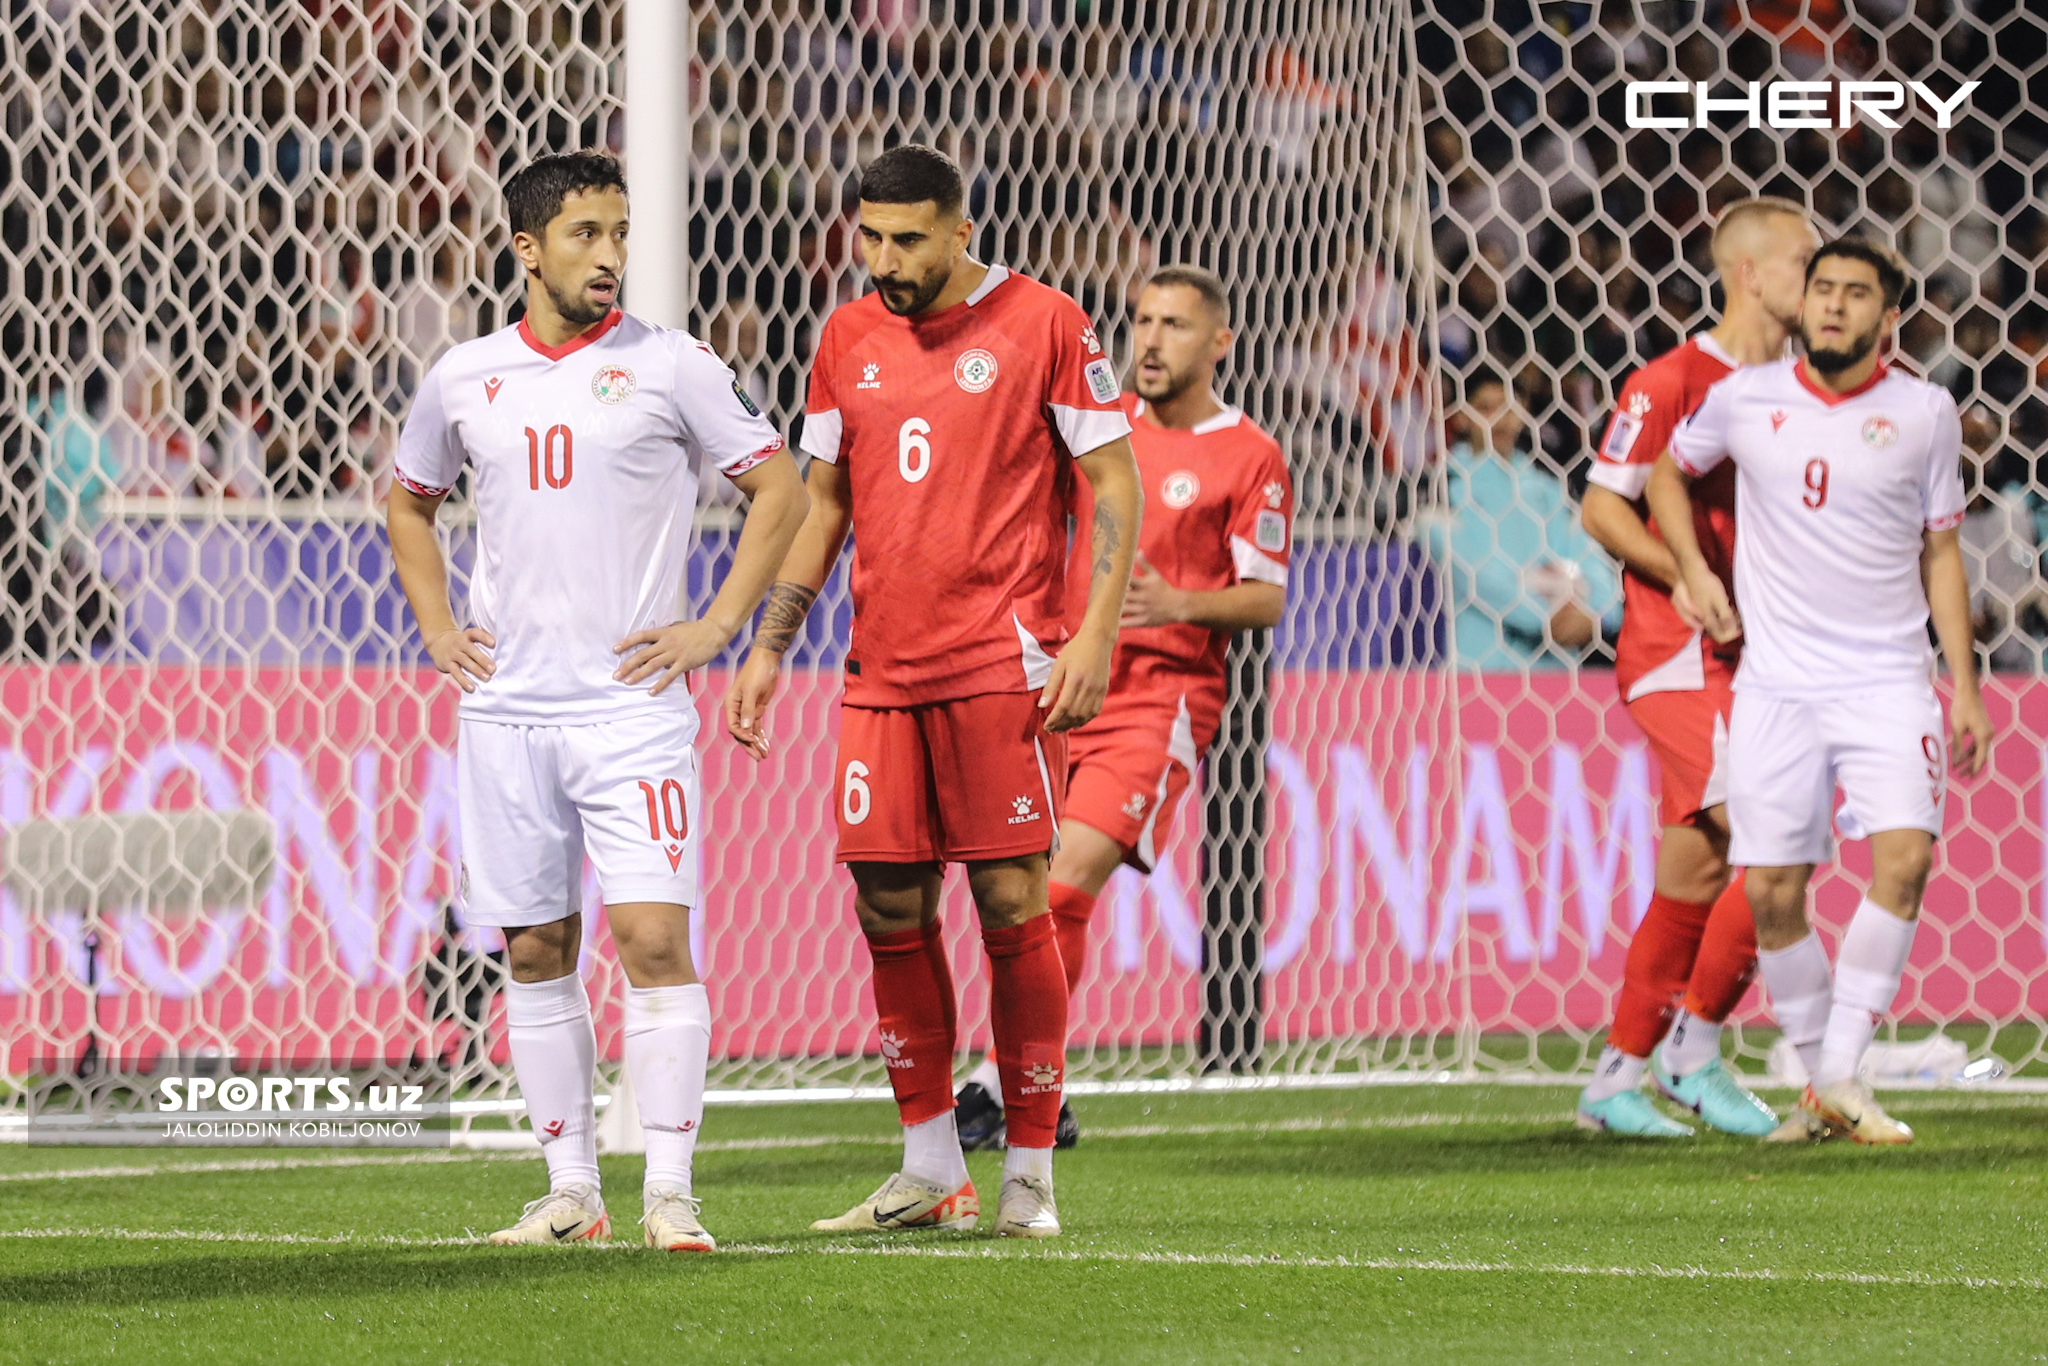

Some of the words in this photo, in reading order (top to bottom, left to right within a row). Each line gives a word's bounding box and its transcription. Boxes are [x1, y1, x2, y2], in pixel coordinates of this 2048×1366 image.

[857, 381, 882, 389] KELME
[524, 423, 574, 491] 10
[898, 416, 932, 483] 6
[1802, 457, 1831, 513] 9
[638, 778, 688, 841] 10
[843, 759, 871, 826] 6
[1007, 811, 1040, 825] KELME
[1021, 1083, 1062, 1095] KELM
